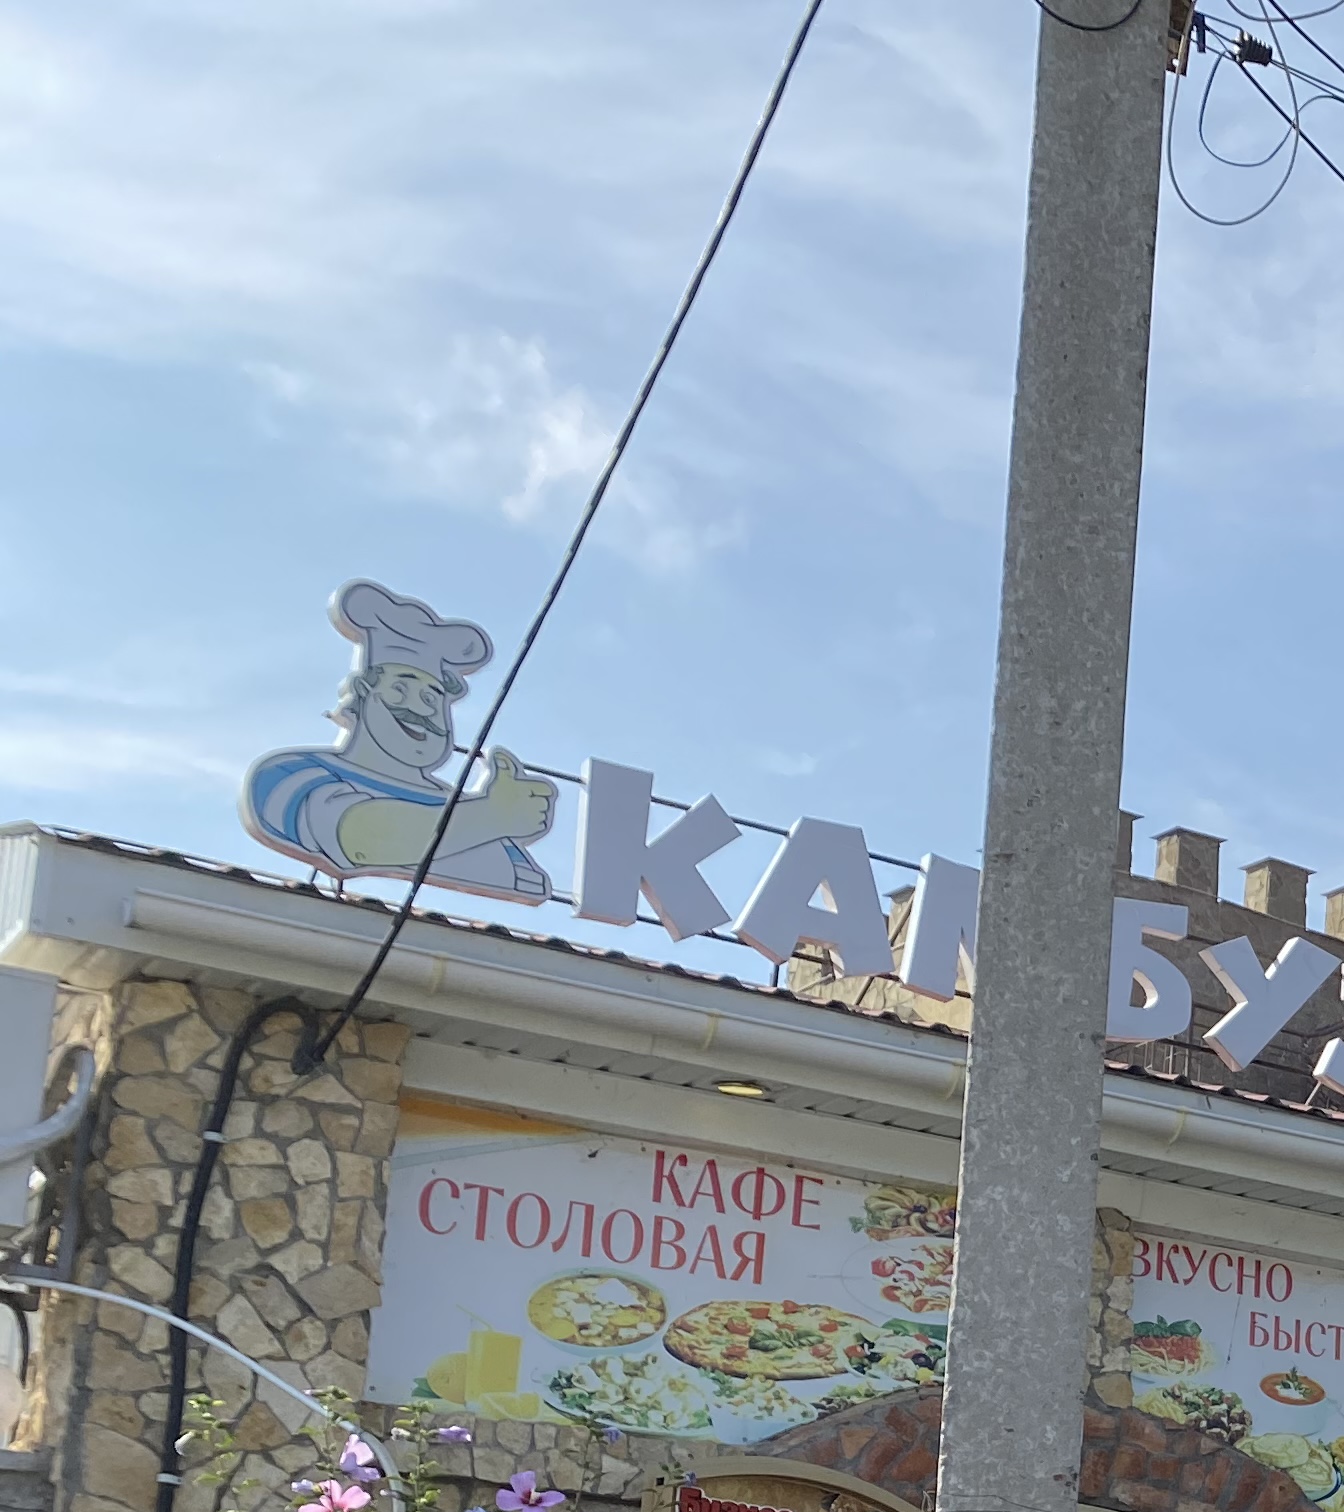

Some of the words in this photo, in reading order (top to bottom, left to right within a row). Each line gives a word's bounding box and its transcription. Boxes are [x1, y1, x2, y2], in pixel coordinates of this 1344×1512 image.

[652, 1149, 823, 1231] КАФЕ
[418, 1177, 767, 1286] СТОЛОВАЯ
[1131, 1237, 1294, 1302] ВКУСНО
